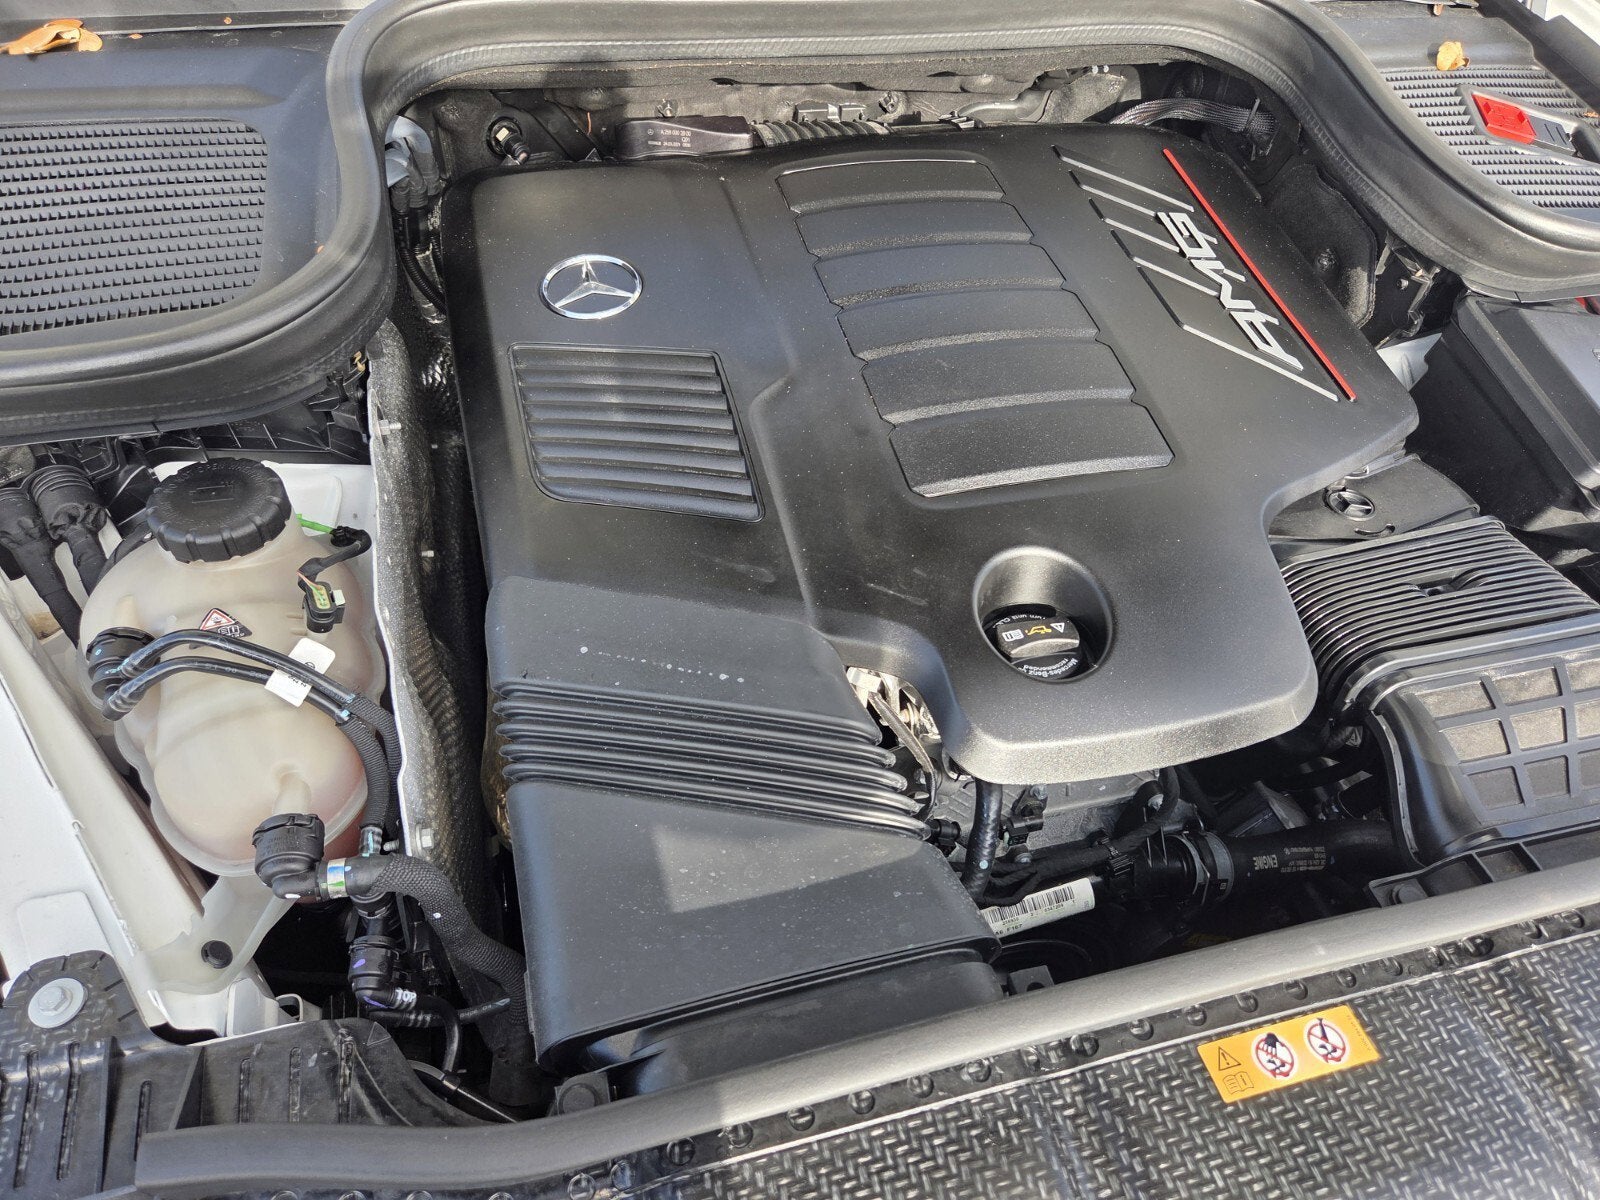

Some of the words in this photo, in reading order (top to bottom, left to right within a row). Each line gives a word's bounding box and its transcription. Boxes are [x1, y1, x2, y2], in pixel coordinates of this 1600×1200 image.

[1156, 212, 1303, 371] AMG
[1028, 658, 1078, 677] Mercedes-Benz
[1253, 854, 1278, 871] ENGINE
[395, 987, 417, 1002] TOP
